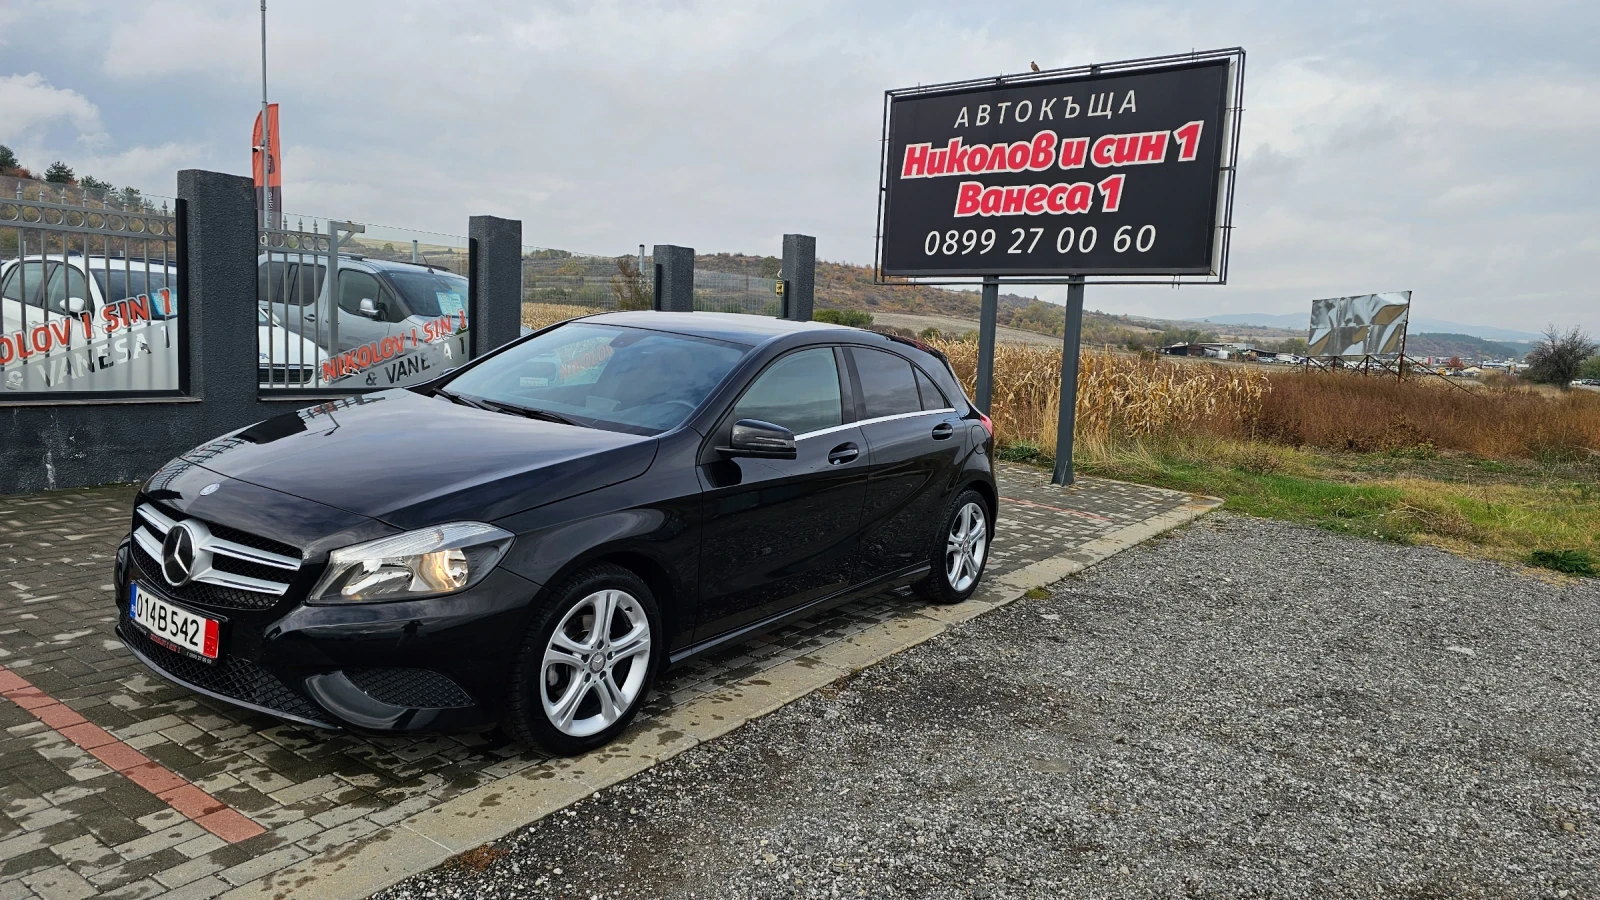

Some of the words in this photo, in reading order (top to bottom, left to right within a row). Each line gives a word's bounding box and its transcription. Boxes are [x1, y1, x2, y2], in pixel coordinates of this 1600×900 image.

[953, 90, 1137, 129] АВТОКЪЩА
[900, 130, 1058, 179] Николов
[1058, 137, 1090, 170] и
[1090, 130, 1171, 168] син
[1172, 120, 1204, 162] 1
[954, 181, 1094, 217] Ванеса
[1097, 174, 1126, 213] 1
[924, 228, 997, 256] 0899
[1007, 227, 1045, 254] 27
[1056, 226, 1098, 254] 00
[1113, 224, 1157, 254] 60
[101, 294, 151, 333] SIN
[158, 287, 172, 316] 1
[6, 370, 24, 391] &
[36, 332, 152, 388] VANESA
[160, 325, 172, 349] 1
[321, 331, 405, 383] NIKOLOV
[423, 313, 454, 345] SIN
[458, 308, 469, 331] 1
[365, 371, 377, 386] &
[458, 337, 465, 355] 1
